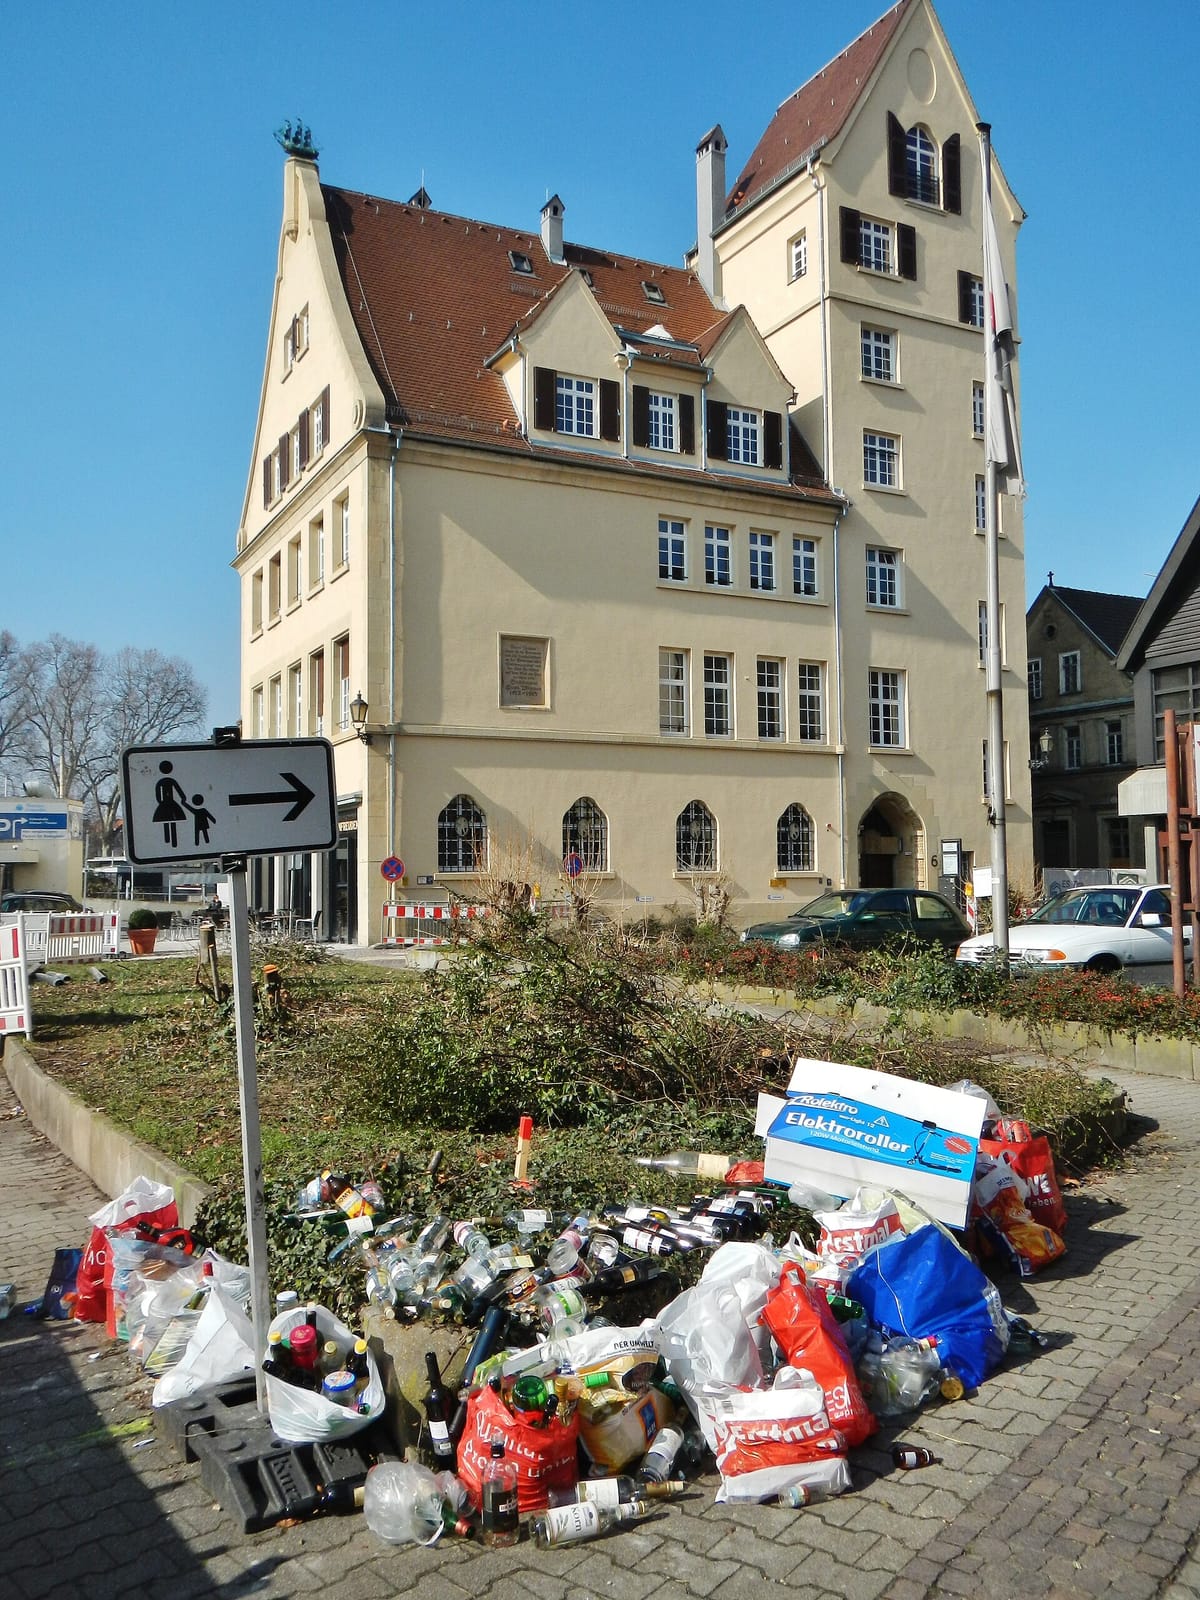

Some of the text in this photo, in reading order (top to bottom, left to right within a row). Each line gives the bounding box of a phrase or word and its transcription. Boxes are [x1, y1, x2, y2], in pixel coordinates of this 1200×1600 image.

[931, 855, 938, 867] 6
[792, 1095, 858, 1115] Rolektro
[785, 1111, 911, 1153] Elektroroller
[613, 1341, 629, 1350] DER
